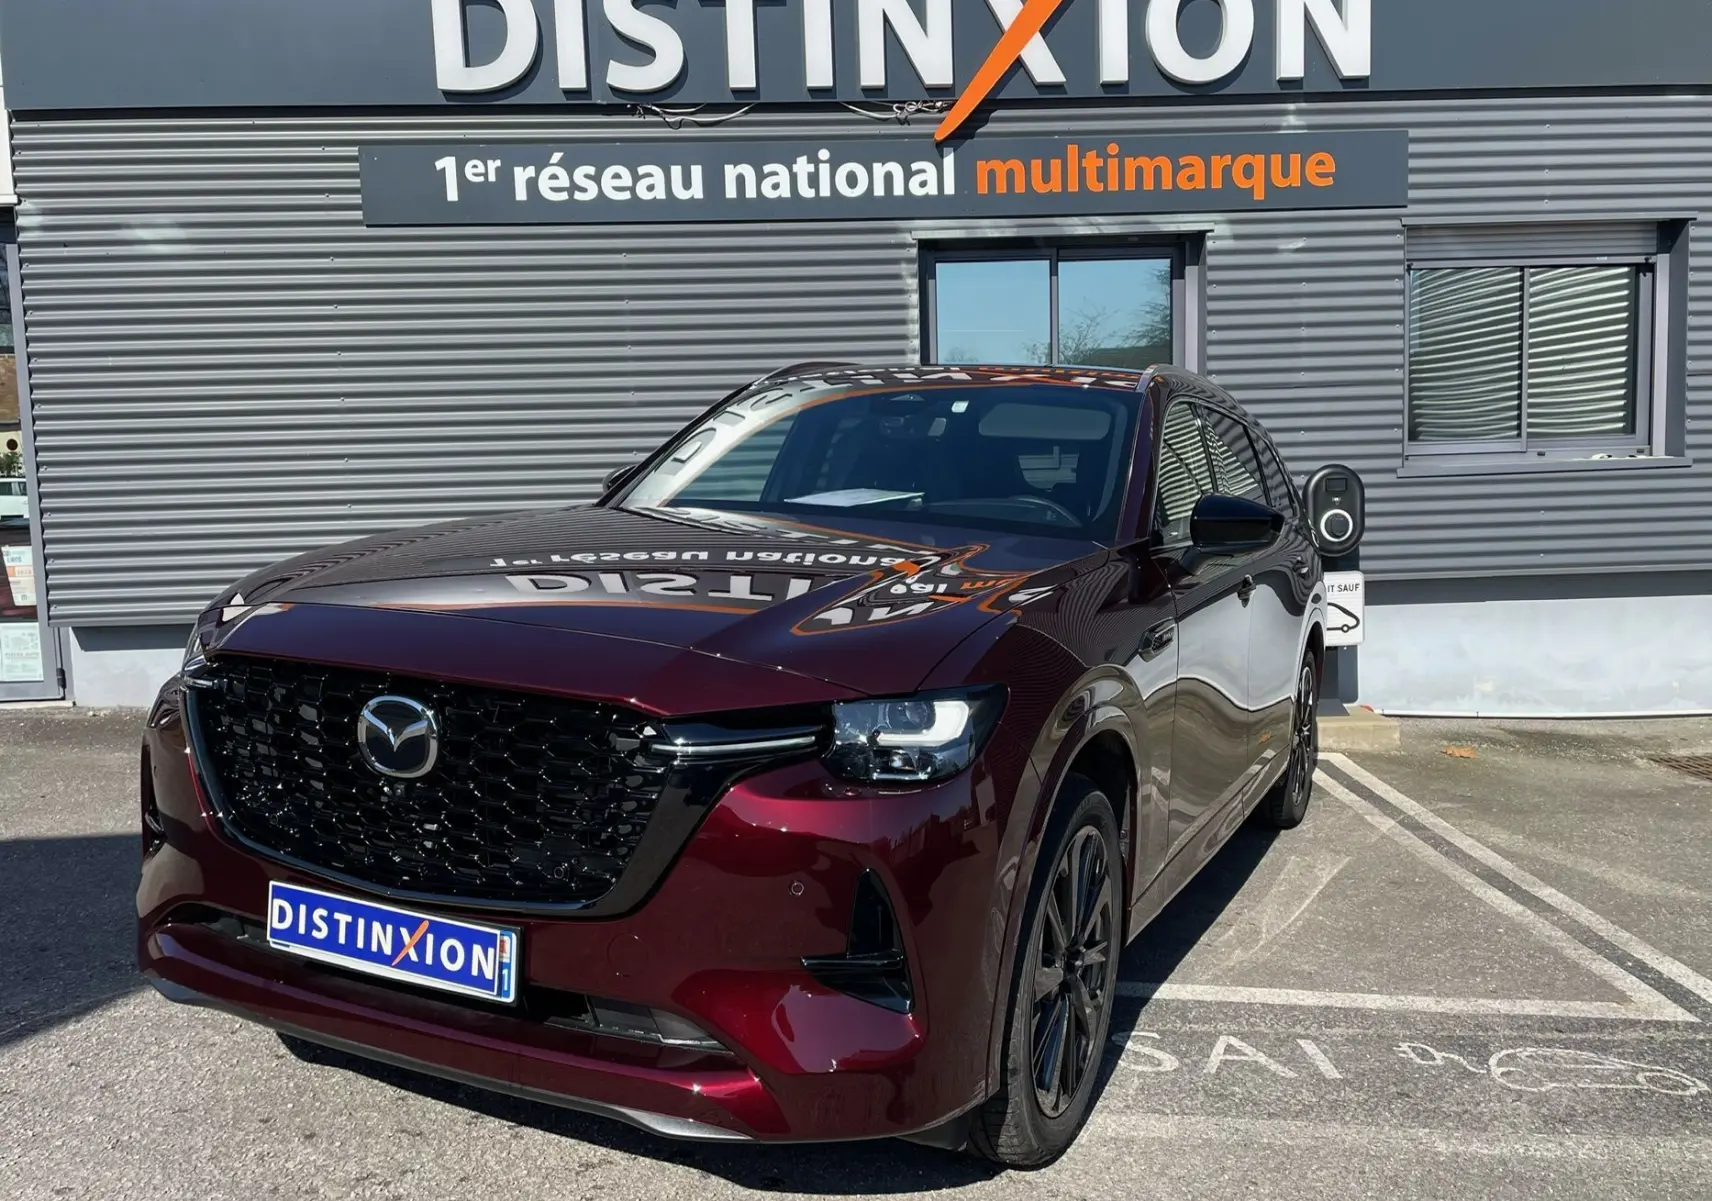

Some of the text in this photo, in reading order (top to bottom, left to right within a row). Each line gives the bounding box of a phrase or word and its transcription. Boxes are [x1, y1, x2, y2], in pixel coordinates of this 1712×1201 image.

[431, 0, 1371, 142] DISTINXION
[434, 142, 1336, 202] 1er réseau national multimarque
[1337, 583, 1360, 592] SAUF
[271, 898, 495, 980] DISTINXION
